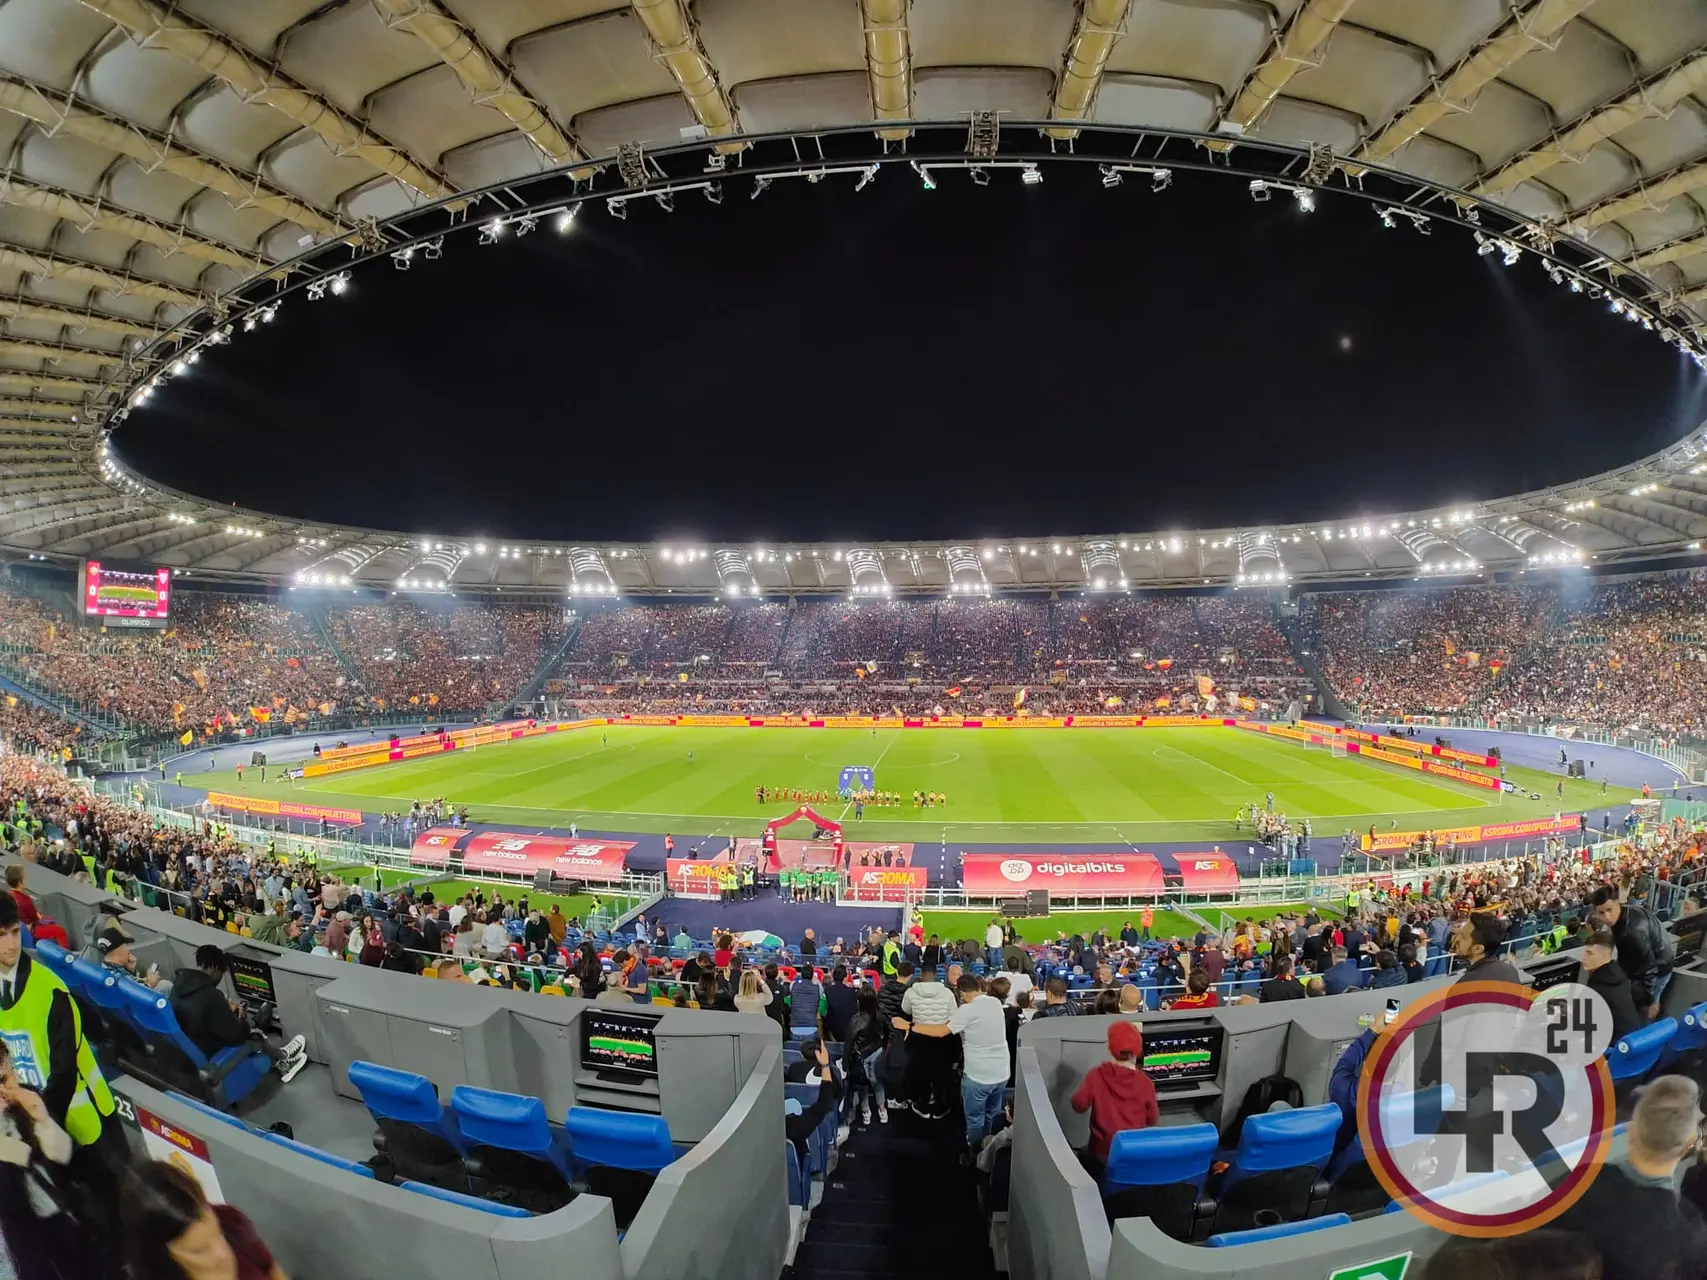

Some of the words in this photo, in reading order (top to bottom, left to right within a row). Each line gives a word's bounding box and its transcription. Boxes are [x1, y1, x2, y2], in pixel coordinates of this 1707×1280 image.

[425, 836, 448, 845] ASR
[497, 850, 528, 860] balance
[571, 857, 603, 866] balance
[1194, 861, 1221, 871] ASR
[1036, 862, 1125, 876] digitalbits
[861, 871, 917, 885] ASROMA
[114, 1096, 135, 1121] 23
